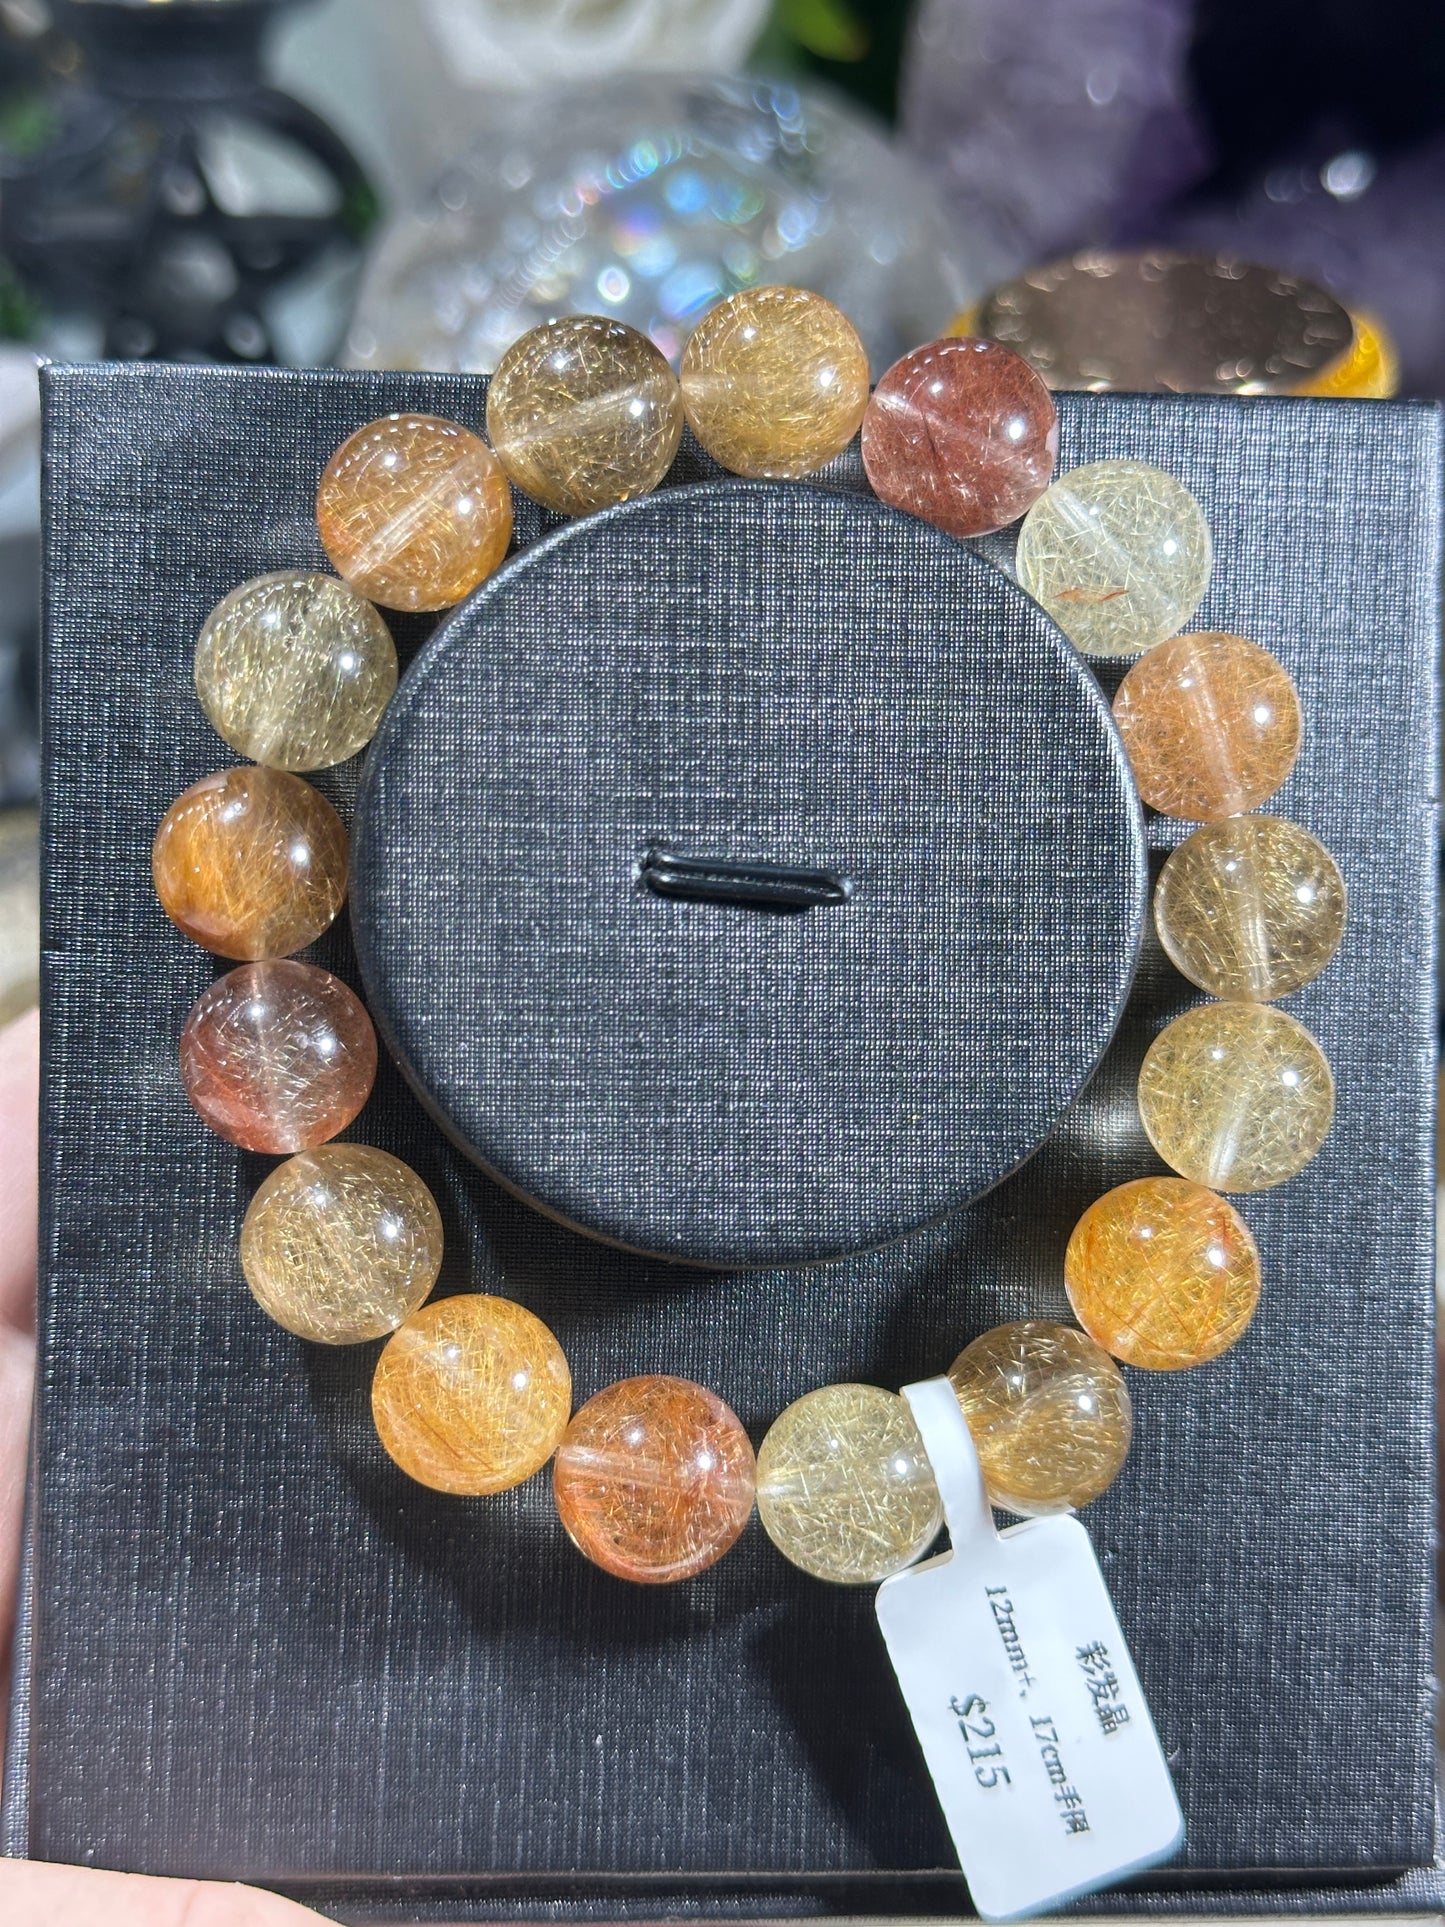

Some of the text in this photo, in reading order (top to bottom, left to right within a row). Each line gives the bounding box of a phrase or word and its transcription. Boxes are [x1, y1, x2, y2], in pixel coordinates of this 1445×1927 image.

[1074, 1639, 1130, 1736] 彩发晶
[948, 1692, 1012, 1789] $215
